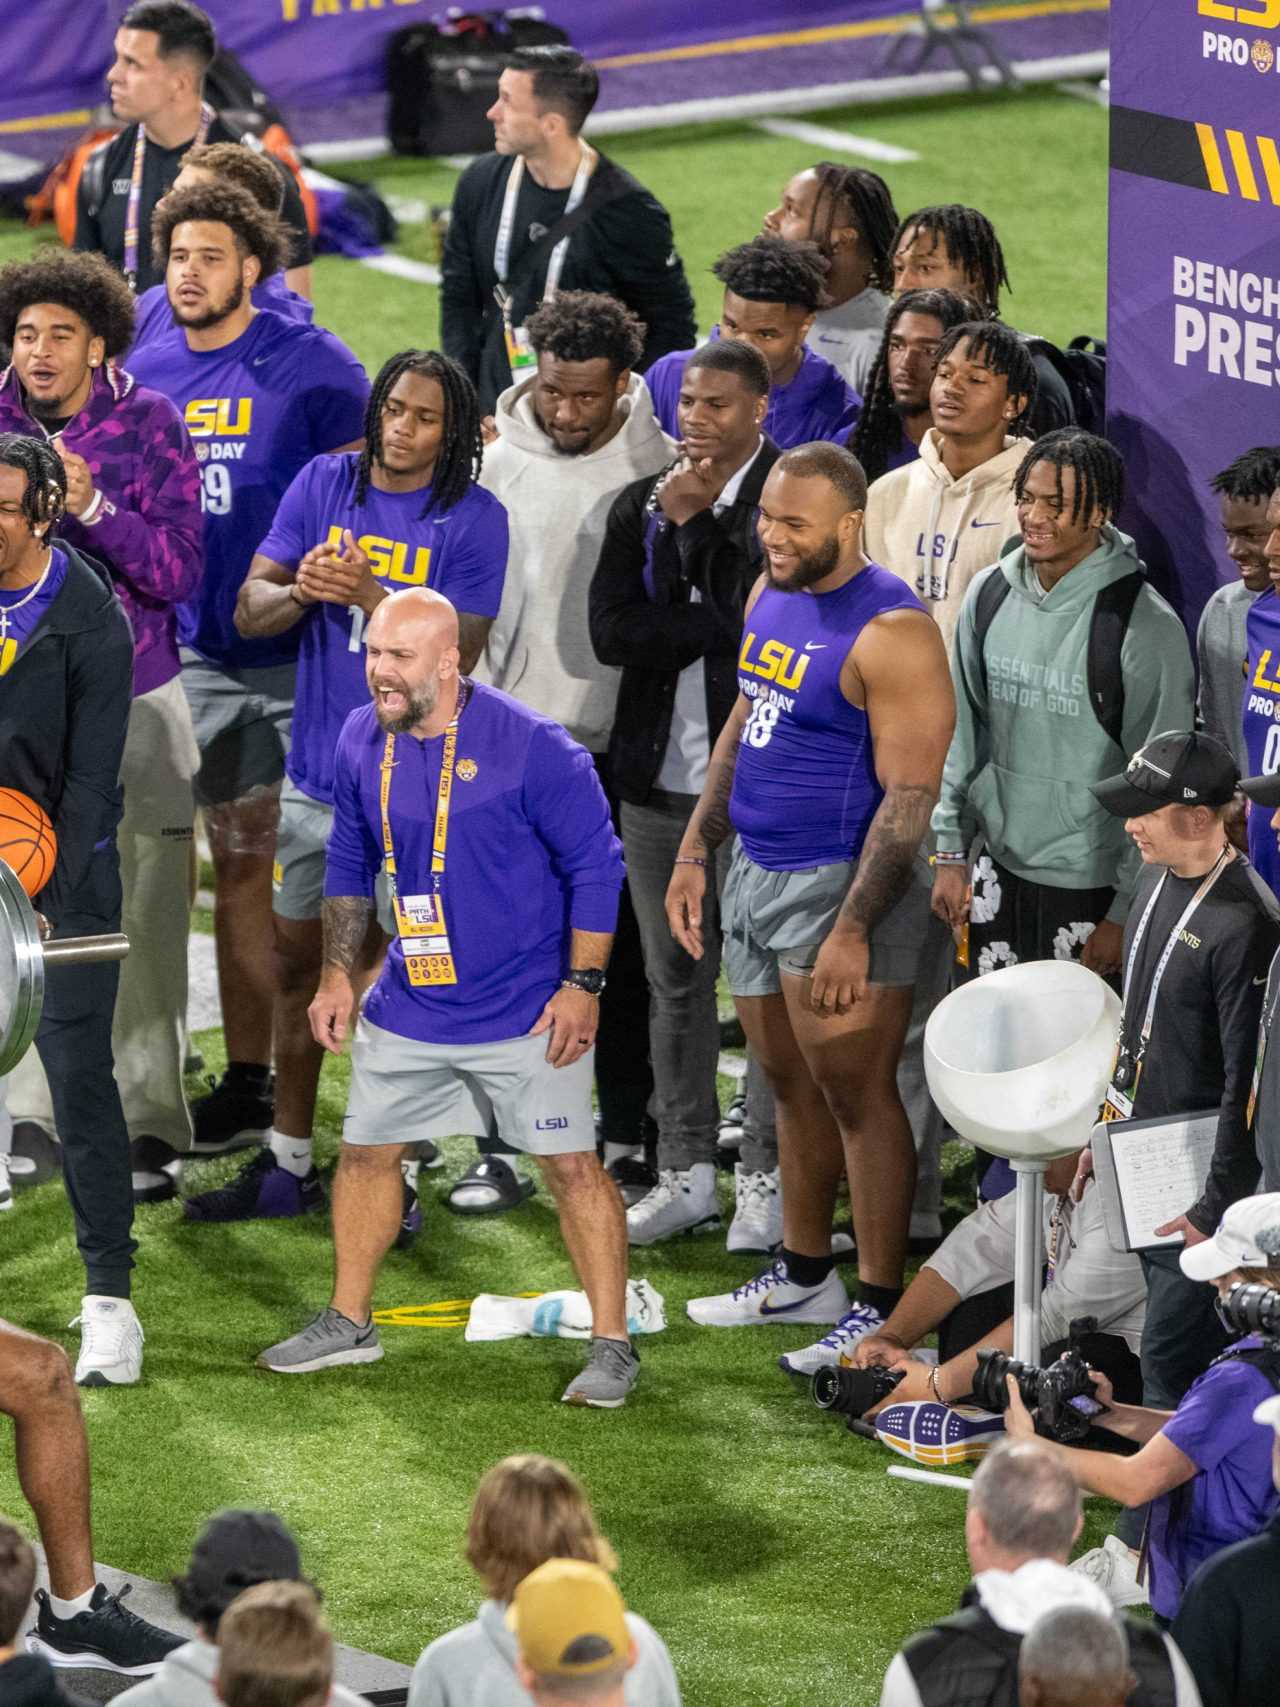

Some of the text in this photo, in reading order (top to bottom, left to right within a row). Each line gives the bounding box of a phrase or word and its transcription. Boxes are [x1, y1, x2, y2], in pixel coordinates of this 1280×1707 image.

[1202, 30, 1250, 66] PRO
[1173, 255, 1280, 320] BENCH
[1174, 303, 1280, 388] PRE
[210, 442, 247, 460] DAY
[347, 604, 370, 654] 1
[739, 631, 811, 691] LSU
[987, 654, 1084, 696] SSENTIALS
[738, 677, 796, 713] PRO DAY
[1019, 685, 1041, 709] OF
[1047, 692, 1079, 717] GOD
[1247, 694, 1275, 717] PRO
[742, 698, 780, 749] 18
[535, 1116, 569, 1131] LSU
